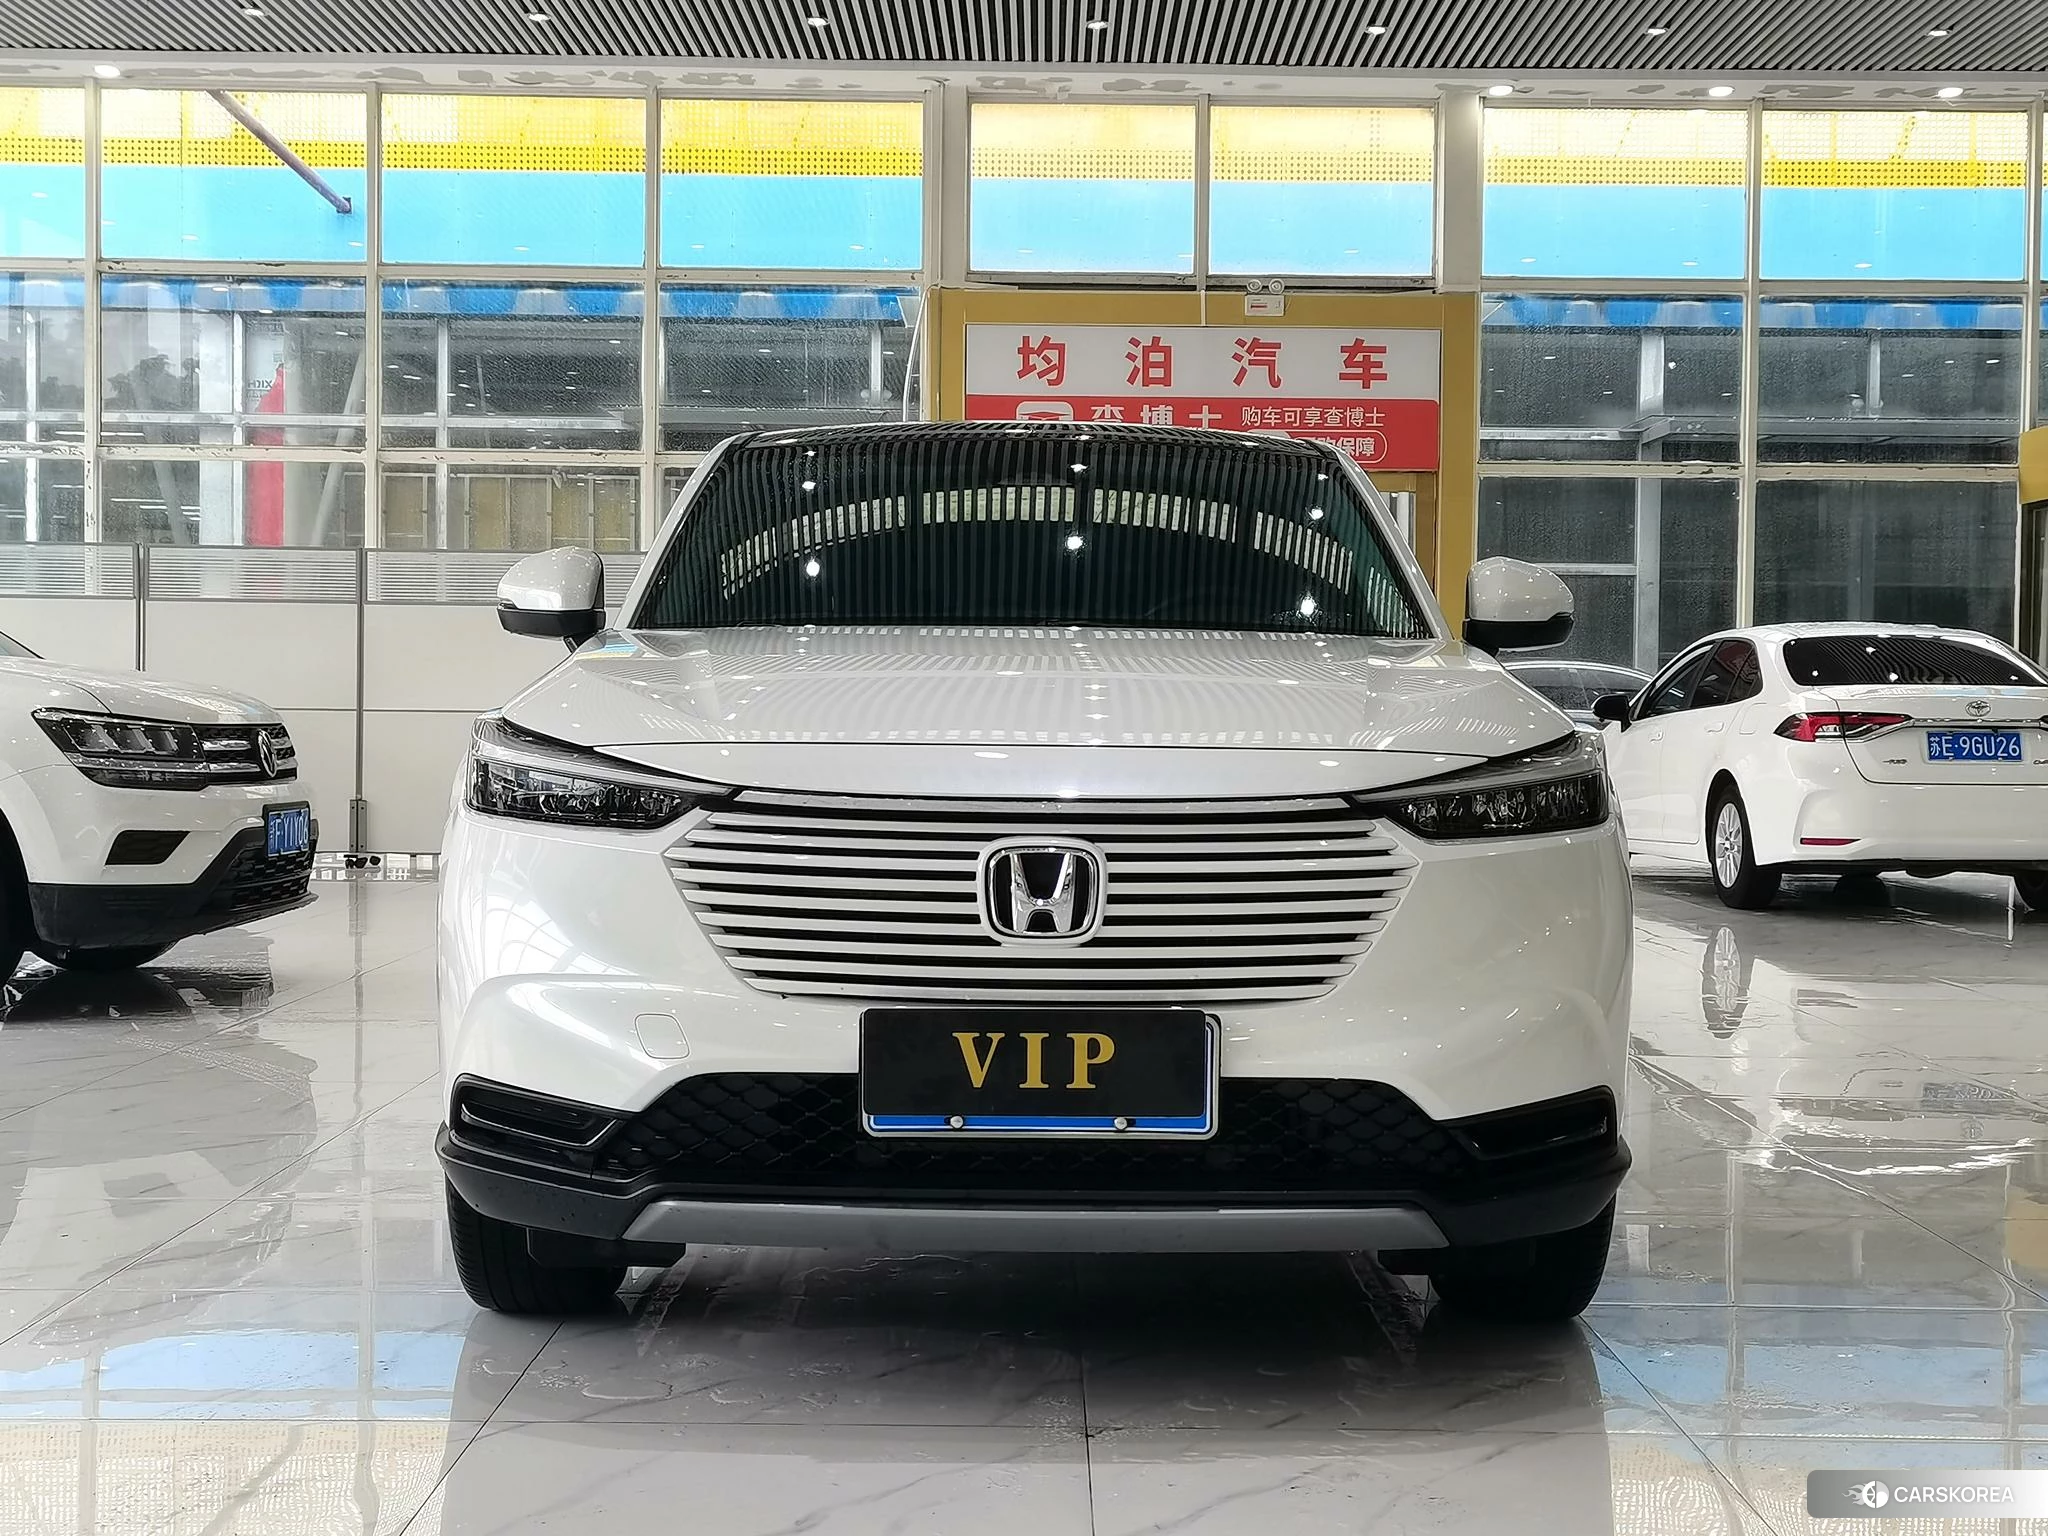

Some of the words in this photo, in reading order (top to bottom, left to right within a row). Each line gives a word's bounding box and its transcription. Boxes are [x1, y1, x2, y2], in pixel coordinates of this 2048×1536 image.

[1016, 335, 1388, 389] 均泊汽车
[1241, 405, 1385, 428] 购车可享查博士
[952, 1032, 1115, 1089] VIP
